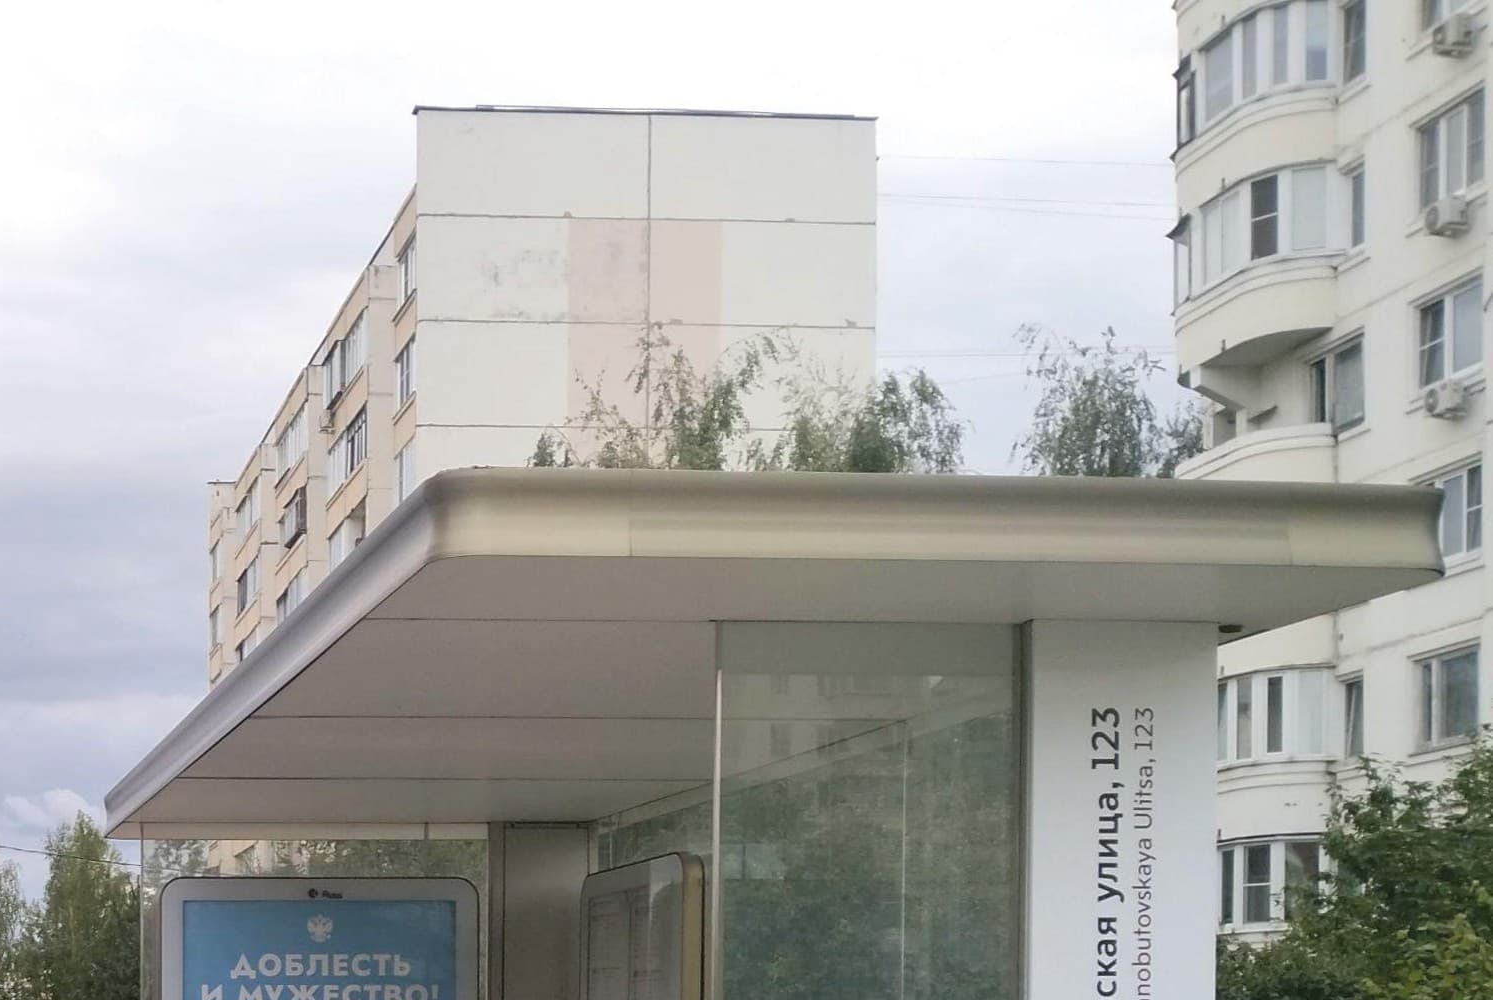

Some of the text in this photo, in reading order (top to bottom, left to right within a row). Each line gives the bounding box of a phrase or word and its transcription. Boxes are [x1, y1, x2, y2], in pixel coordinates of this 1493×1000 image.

[1091, 707, 1120, 770] 123
[1134, 707, 1154, 751] 123
[1133, 758, 1156, 829] Ulitsa,
[1097, 782, 1125, 903] улица,
[230, 953, 411, 979] ДОБЛЕСТЬ
